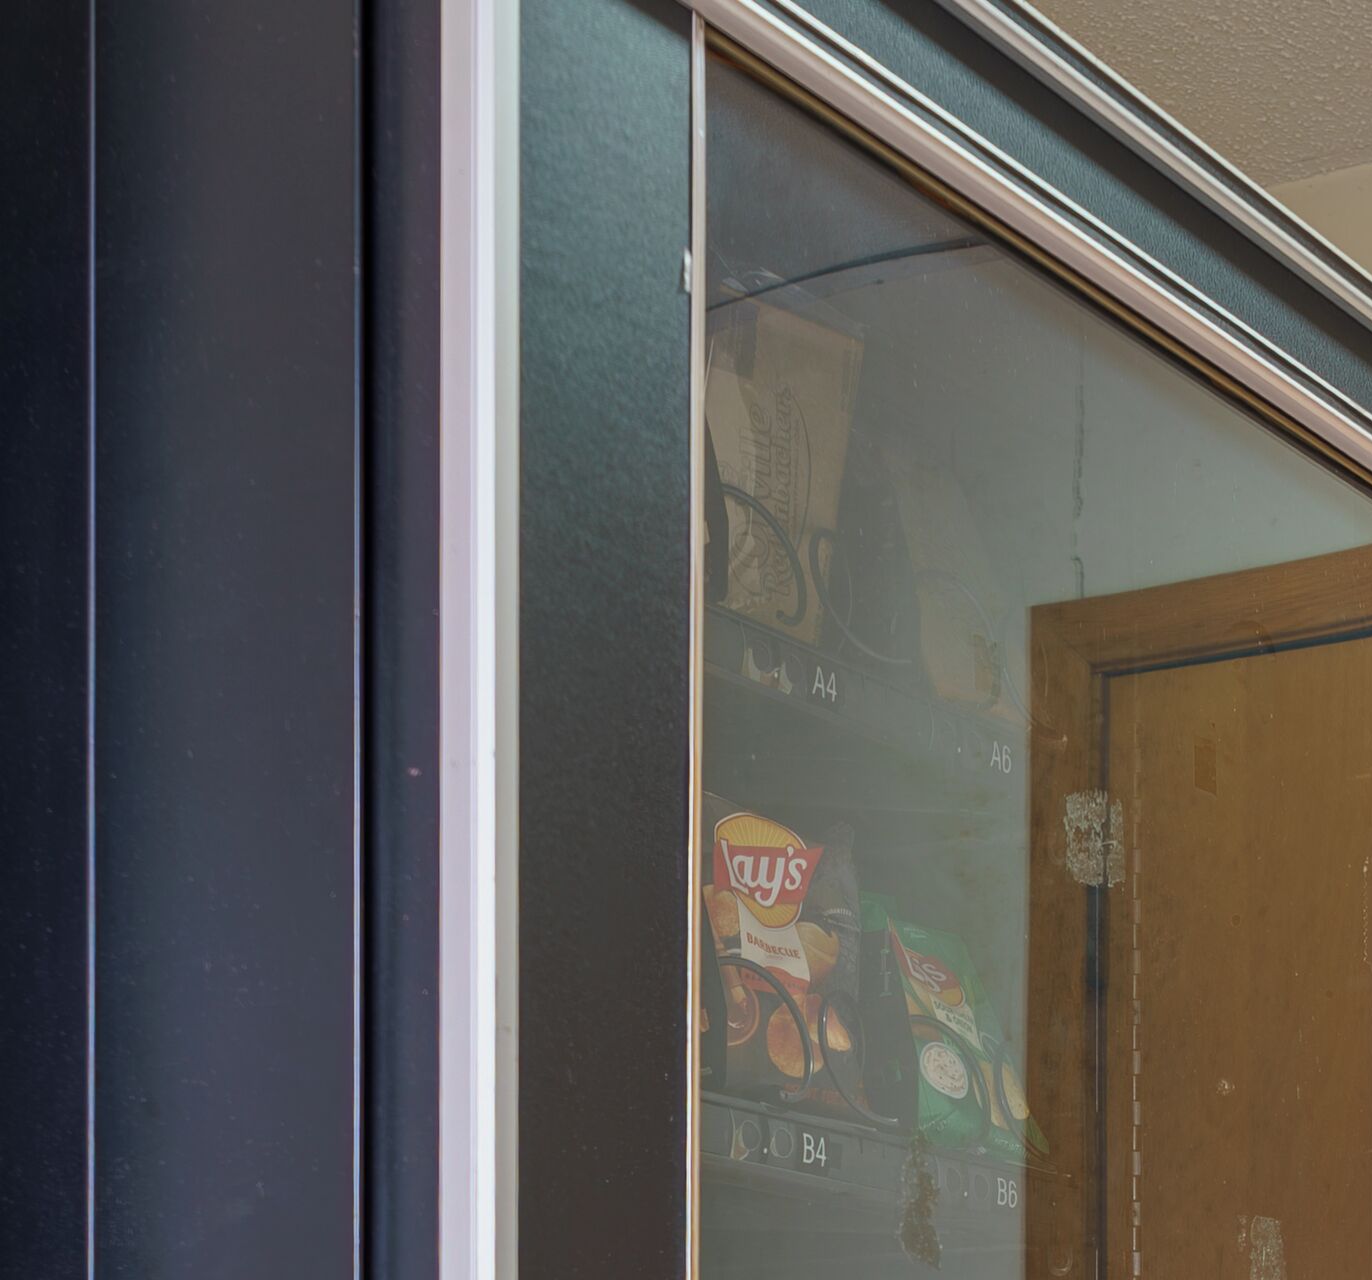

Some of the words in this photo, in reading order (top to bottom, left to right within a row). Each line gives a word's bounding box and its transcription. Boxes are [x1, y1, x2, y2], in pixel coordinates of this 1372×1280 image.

[731, 405, 772, 596] Oville
[812, 666, 837, 702] A4
[989, 740, 1012, 774] A6
[719, 838, 808, 907] Lay's
[746, 931, 801, 959] BARBECUE
[802, 1132, 827, 1168] B4
[997, 1177, 1018, 1209] B6
